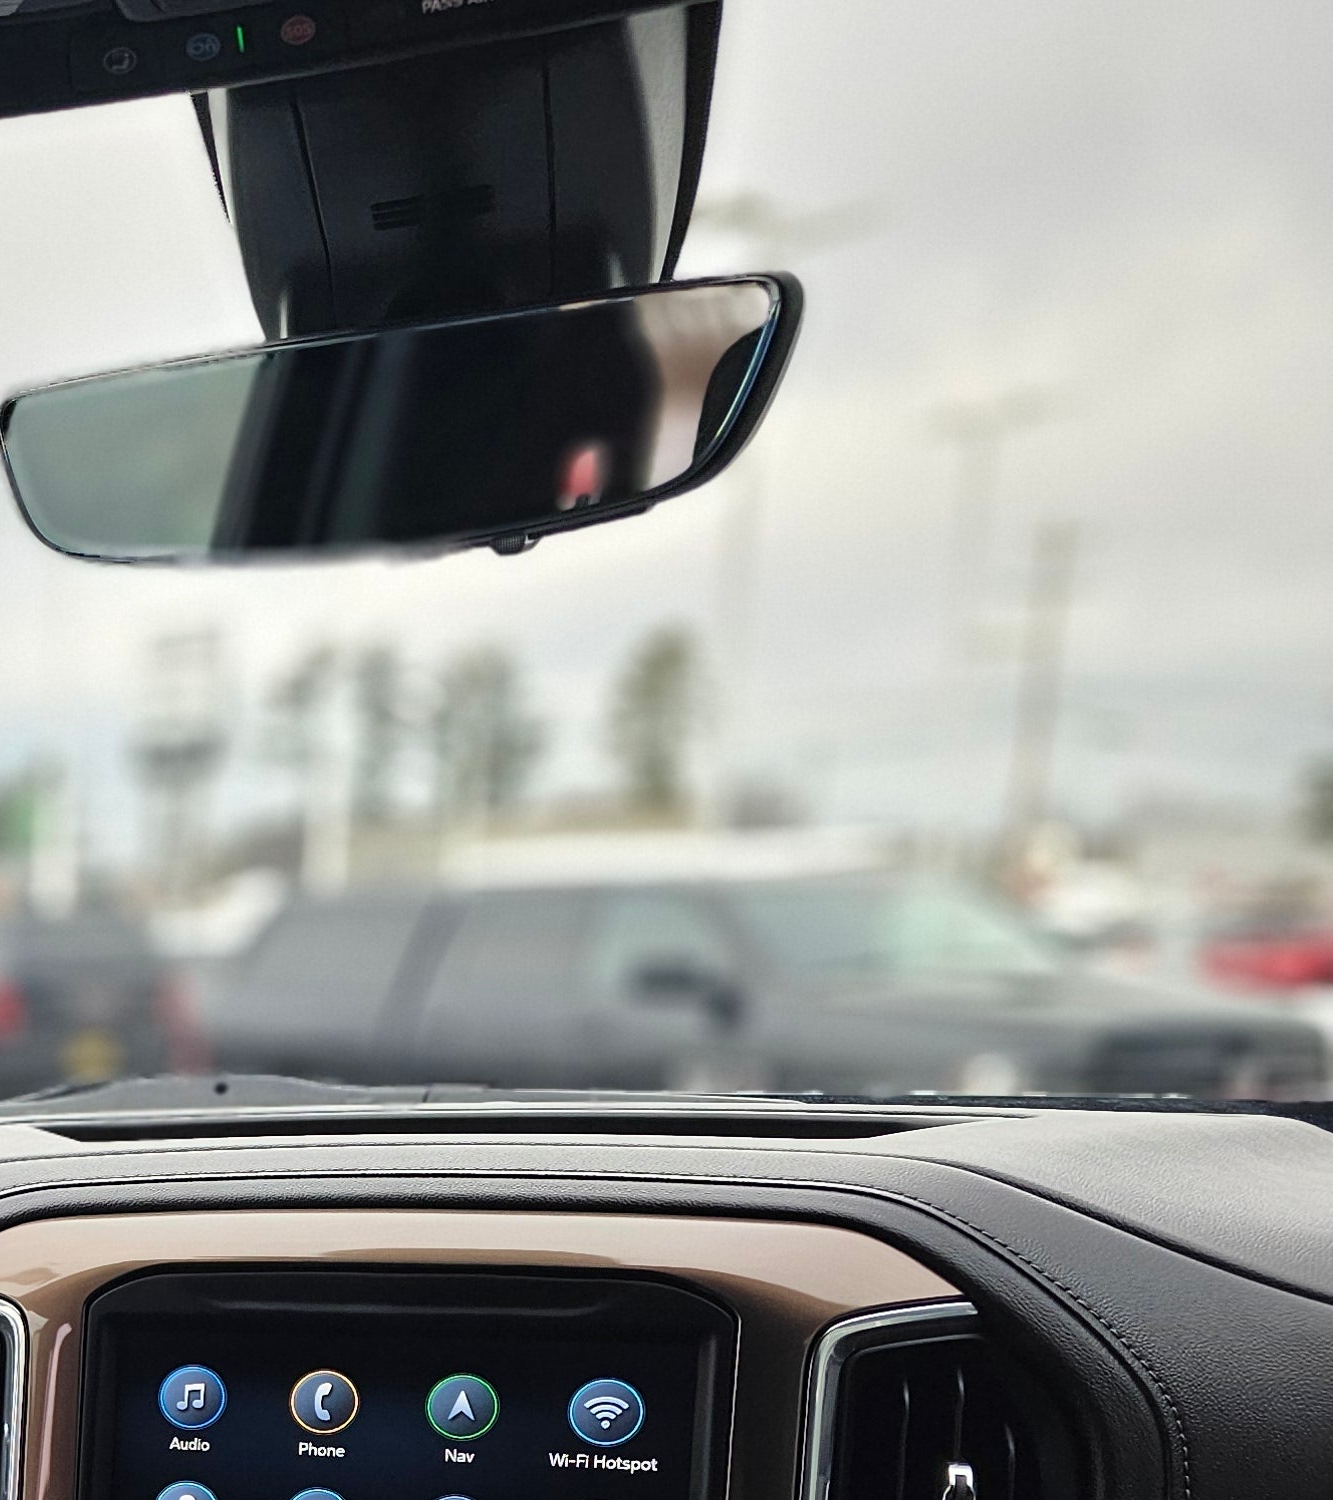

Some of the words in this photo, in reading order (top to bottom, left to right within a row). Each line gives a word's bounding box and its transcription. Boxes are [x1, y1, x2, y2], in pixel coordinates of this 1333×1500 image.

[169, 1436, 211, 1452] Audio
[298, 1441, 346, 1458] Phone
[444, 1448, 475, 1464] Nav
[548, 1452, 589, 1469] Wi-Fi
[593, 1456, 658, 1475] Hotspot
